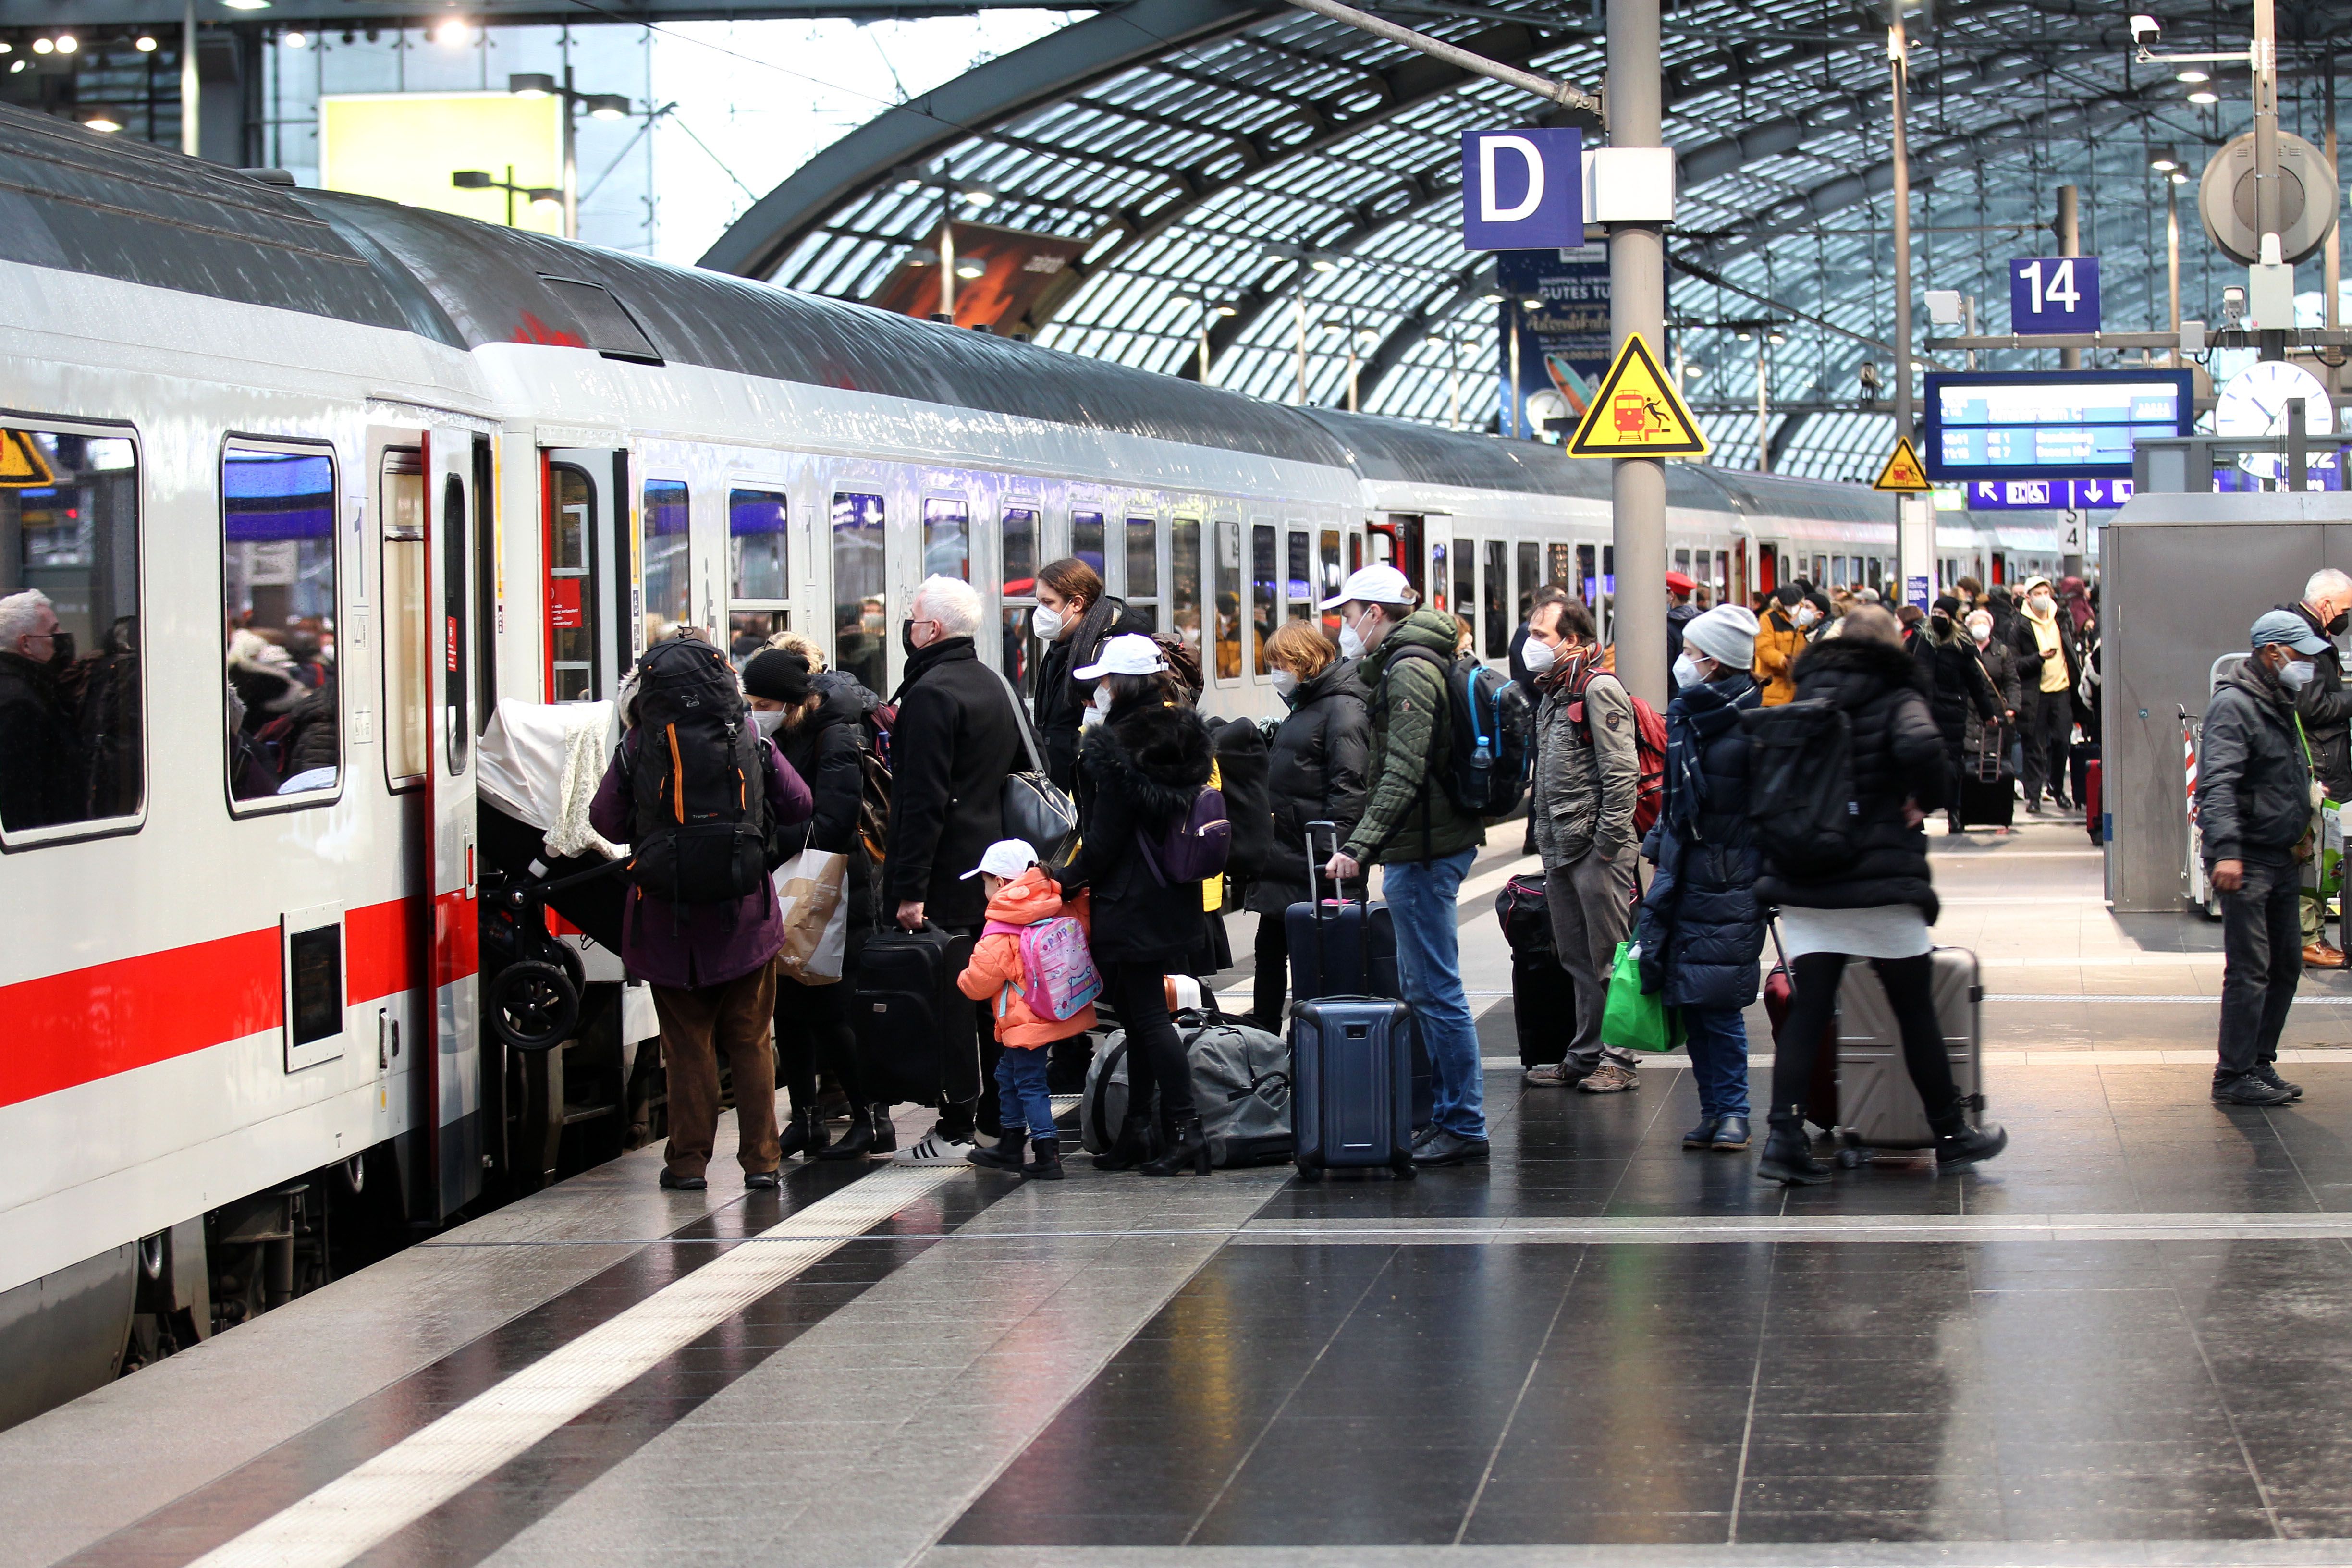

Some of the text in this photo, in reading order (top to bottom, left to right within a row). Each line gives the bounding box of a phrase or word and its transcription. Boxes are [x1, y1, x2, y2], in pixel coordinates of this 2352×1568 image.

[1480, 135, 1545, 222] D
[2019, 259, 2081, 313] 14
[2067, 528, 2078, 546] 4
